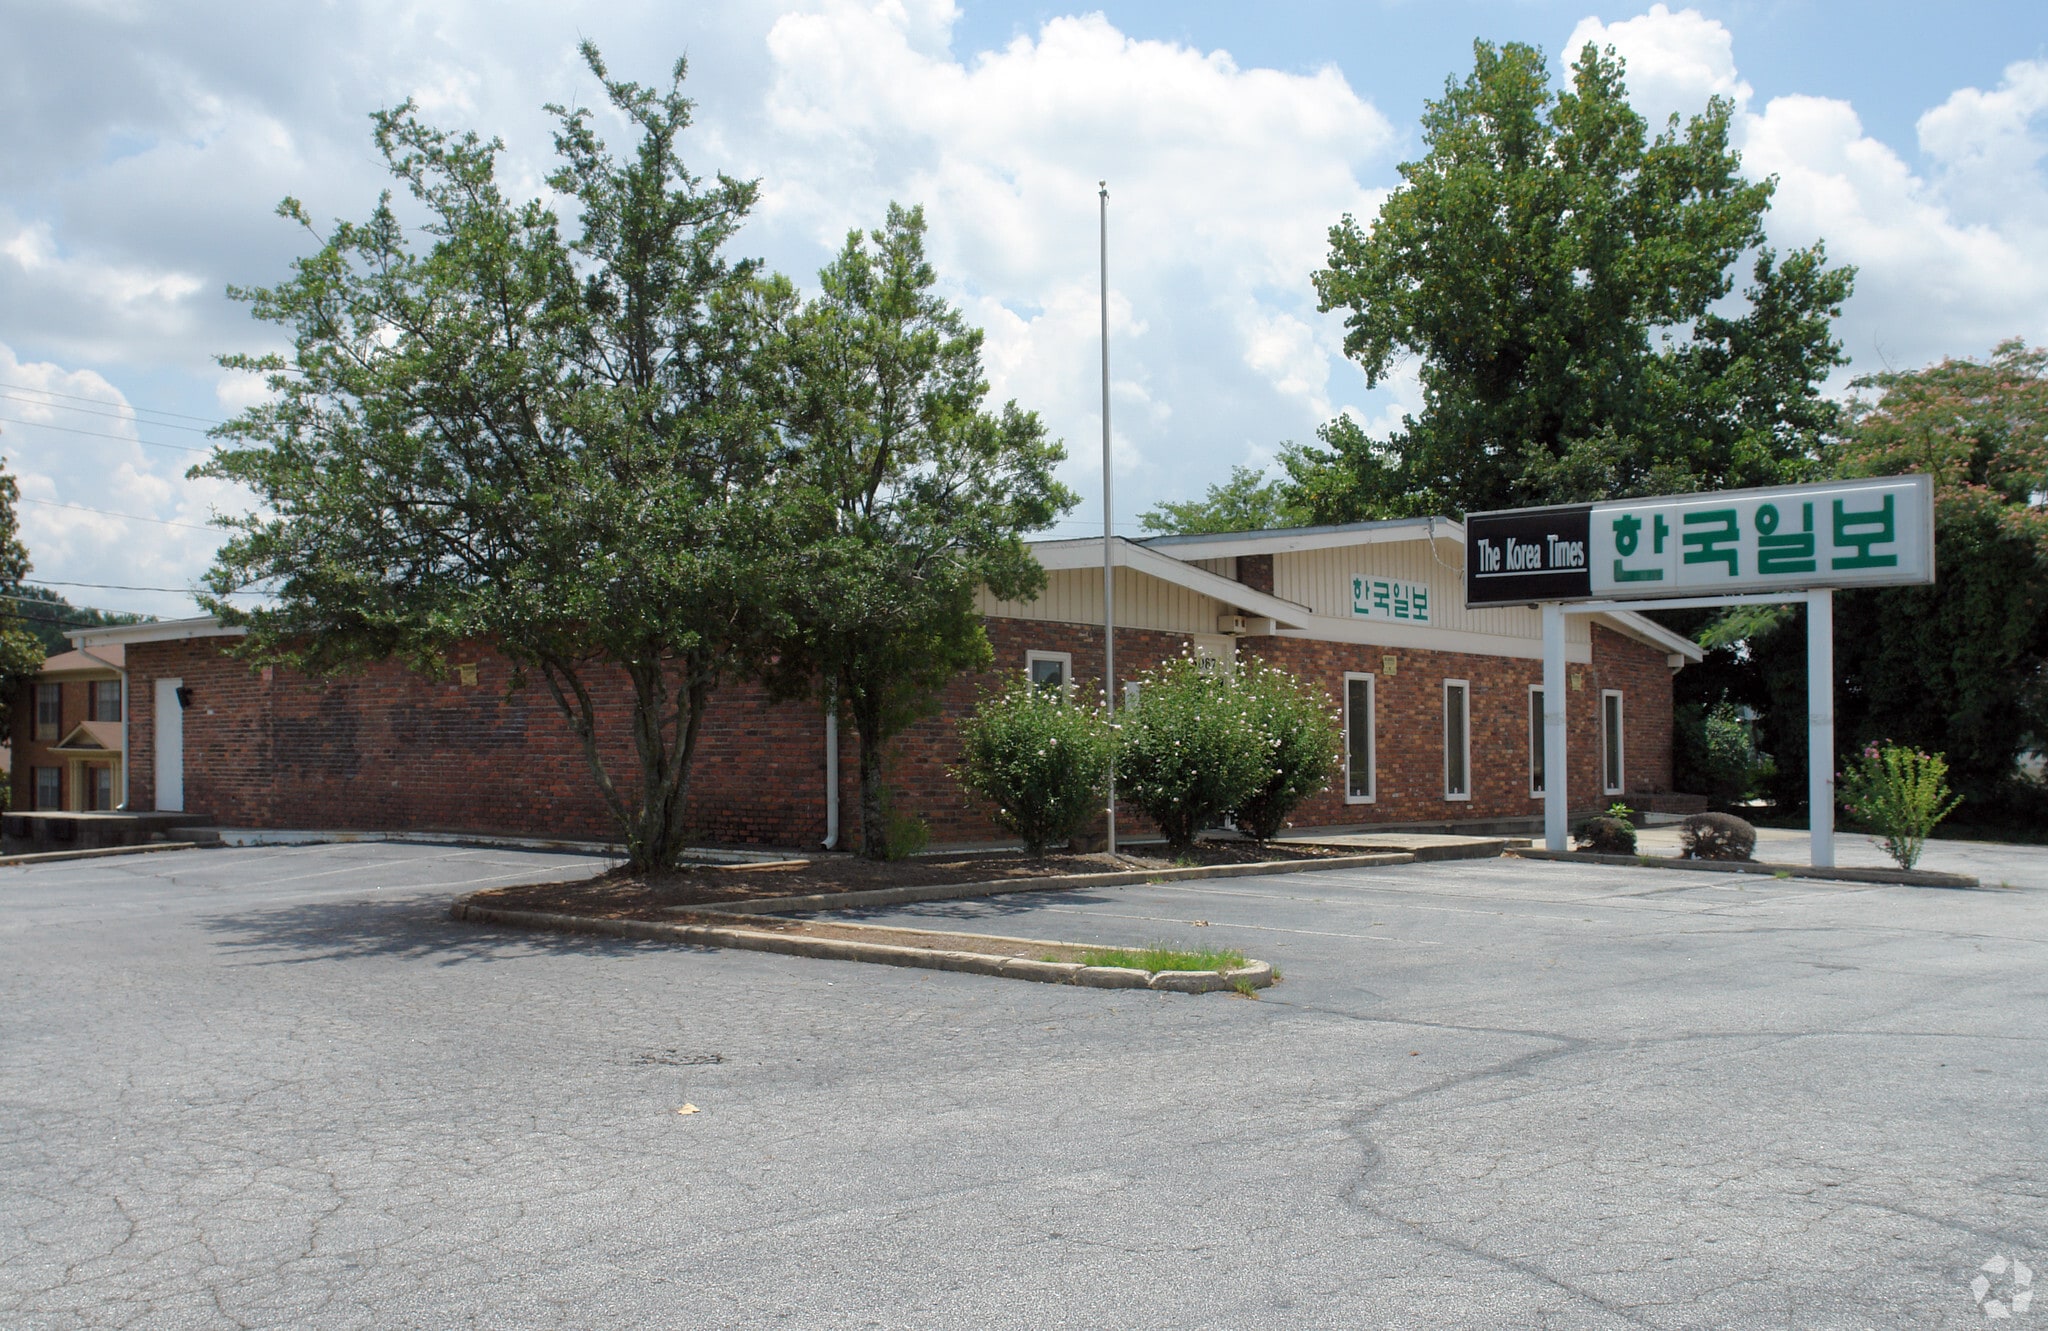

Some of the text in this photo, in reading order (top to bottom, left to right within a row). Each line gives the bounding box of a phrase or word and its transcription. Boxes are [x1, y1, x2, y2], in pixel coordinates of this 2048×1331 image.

[1478, 534, 1585, 572] The Korea Times
[1612, 494, 1898, 582] 한국일보
[1353, 577, 1429, 621] 한국일보
